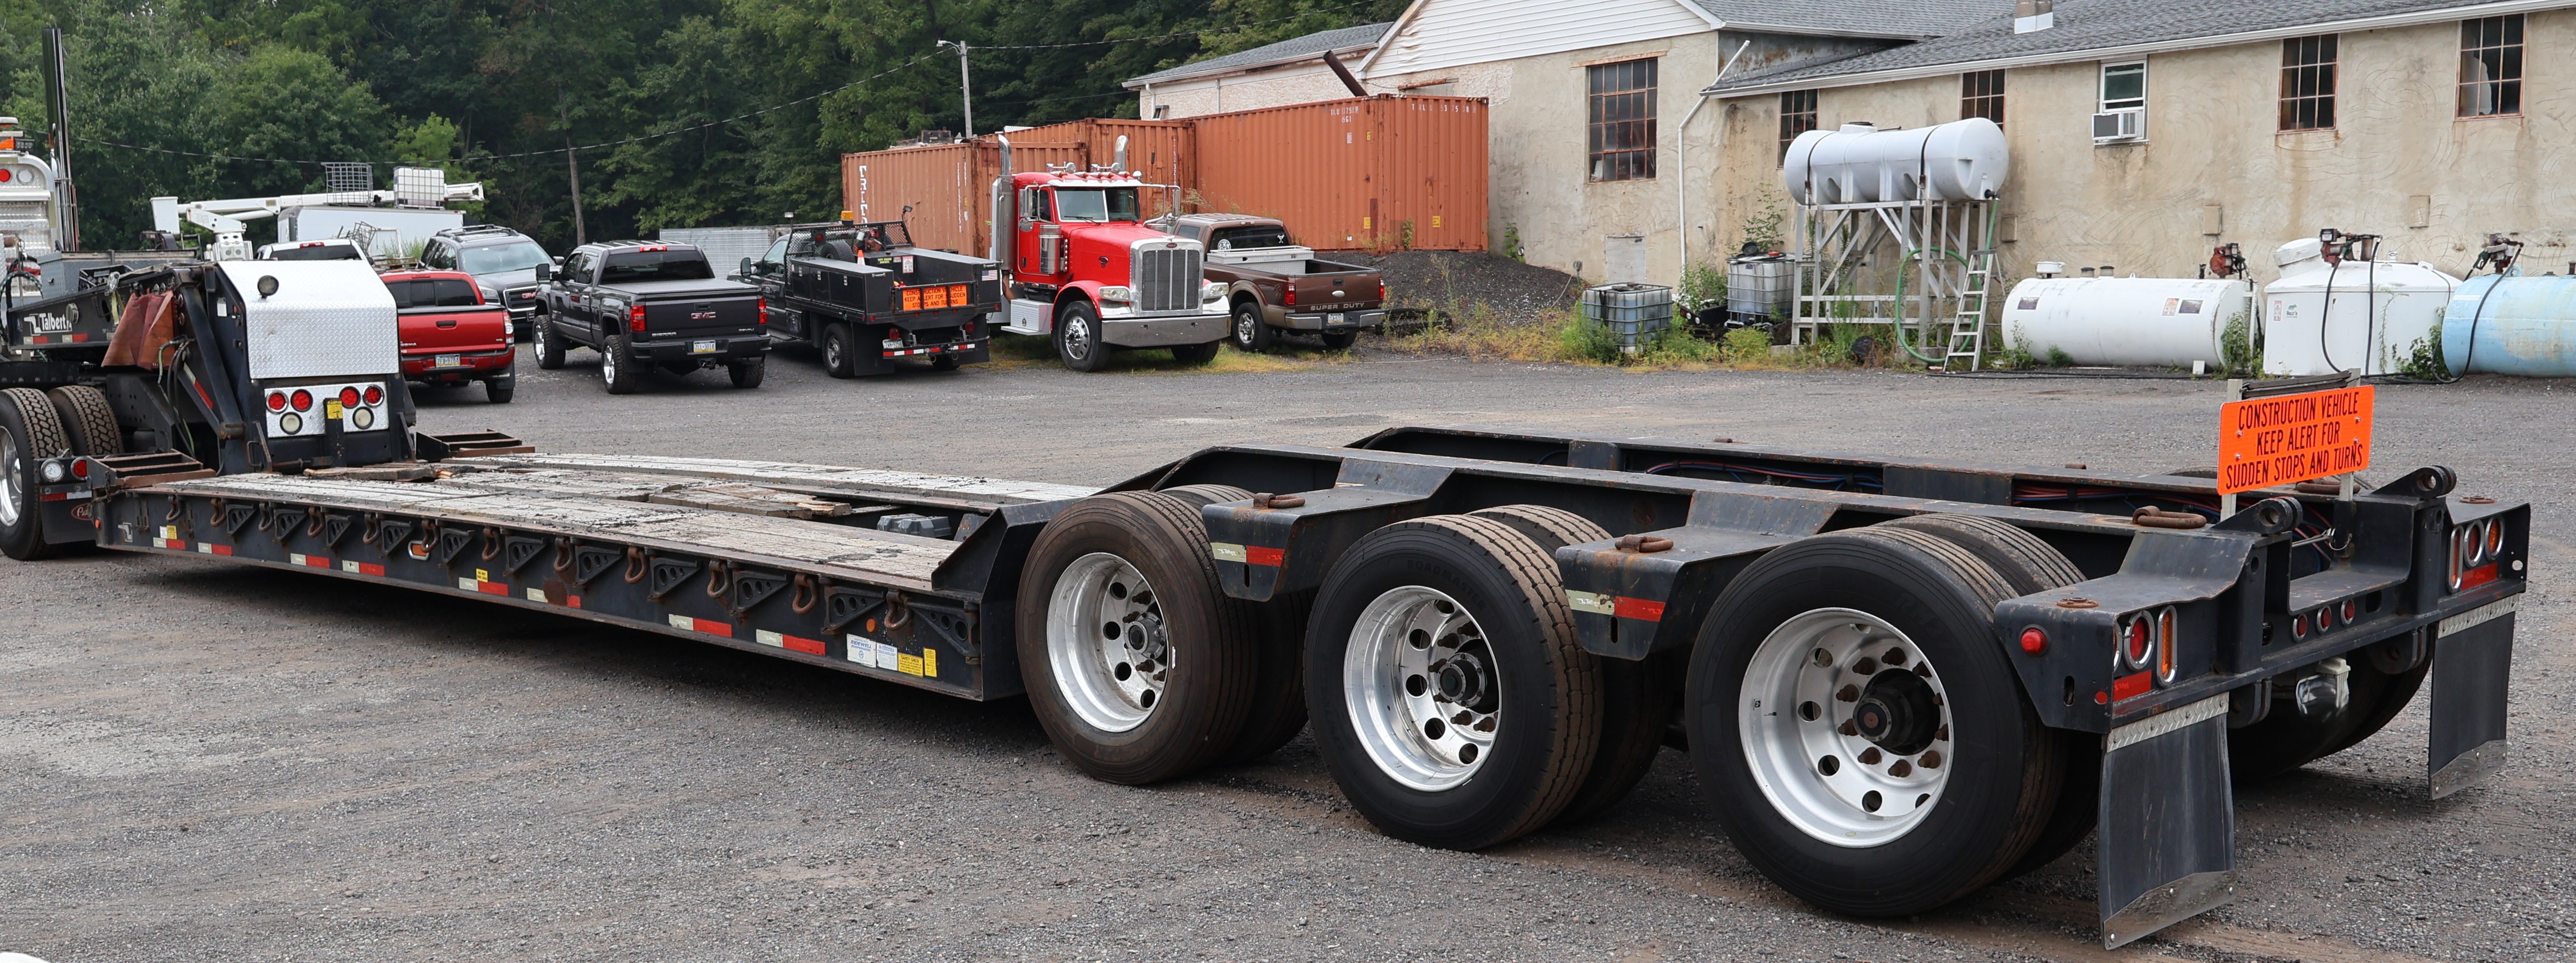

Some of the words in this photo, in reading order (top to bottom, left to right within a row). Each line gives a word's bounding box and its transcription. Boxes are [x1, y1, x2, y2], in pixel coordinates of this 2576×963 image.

[39, 312, 66, 331] Talbert
[2239, 397, 2317, 430] CONSTRUCTION
[2321, 392, 2359, 418] VEHICLE
[2257, 429, 2283, 456] KEEP
[2287, 424, 2318, 451] ALERT
[2322, 421, 2340, 446] FOR
[2226, 459, 2269, 490] SUDDEN
[2274, 453, 2305, 482] STOPS
[2309, 450, 2329, 475] AND
[2334, 444, 2363, 471] TURNS
[1408, 559, 1487, 610] ROADMASTER
[851, 640, 872, 648] RIDEWELL
